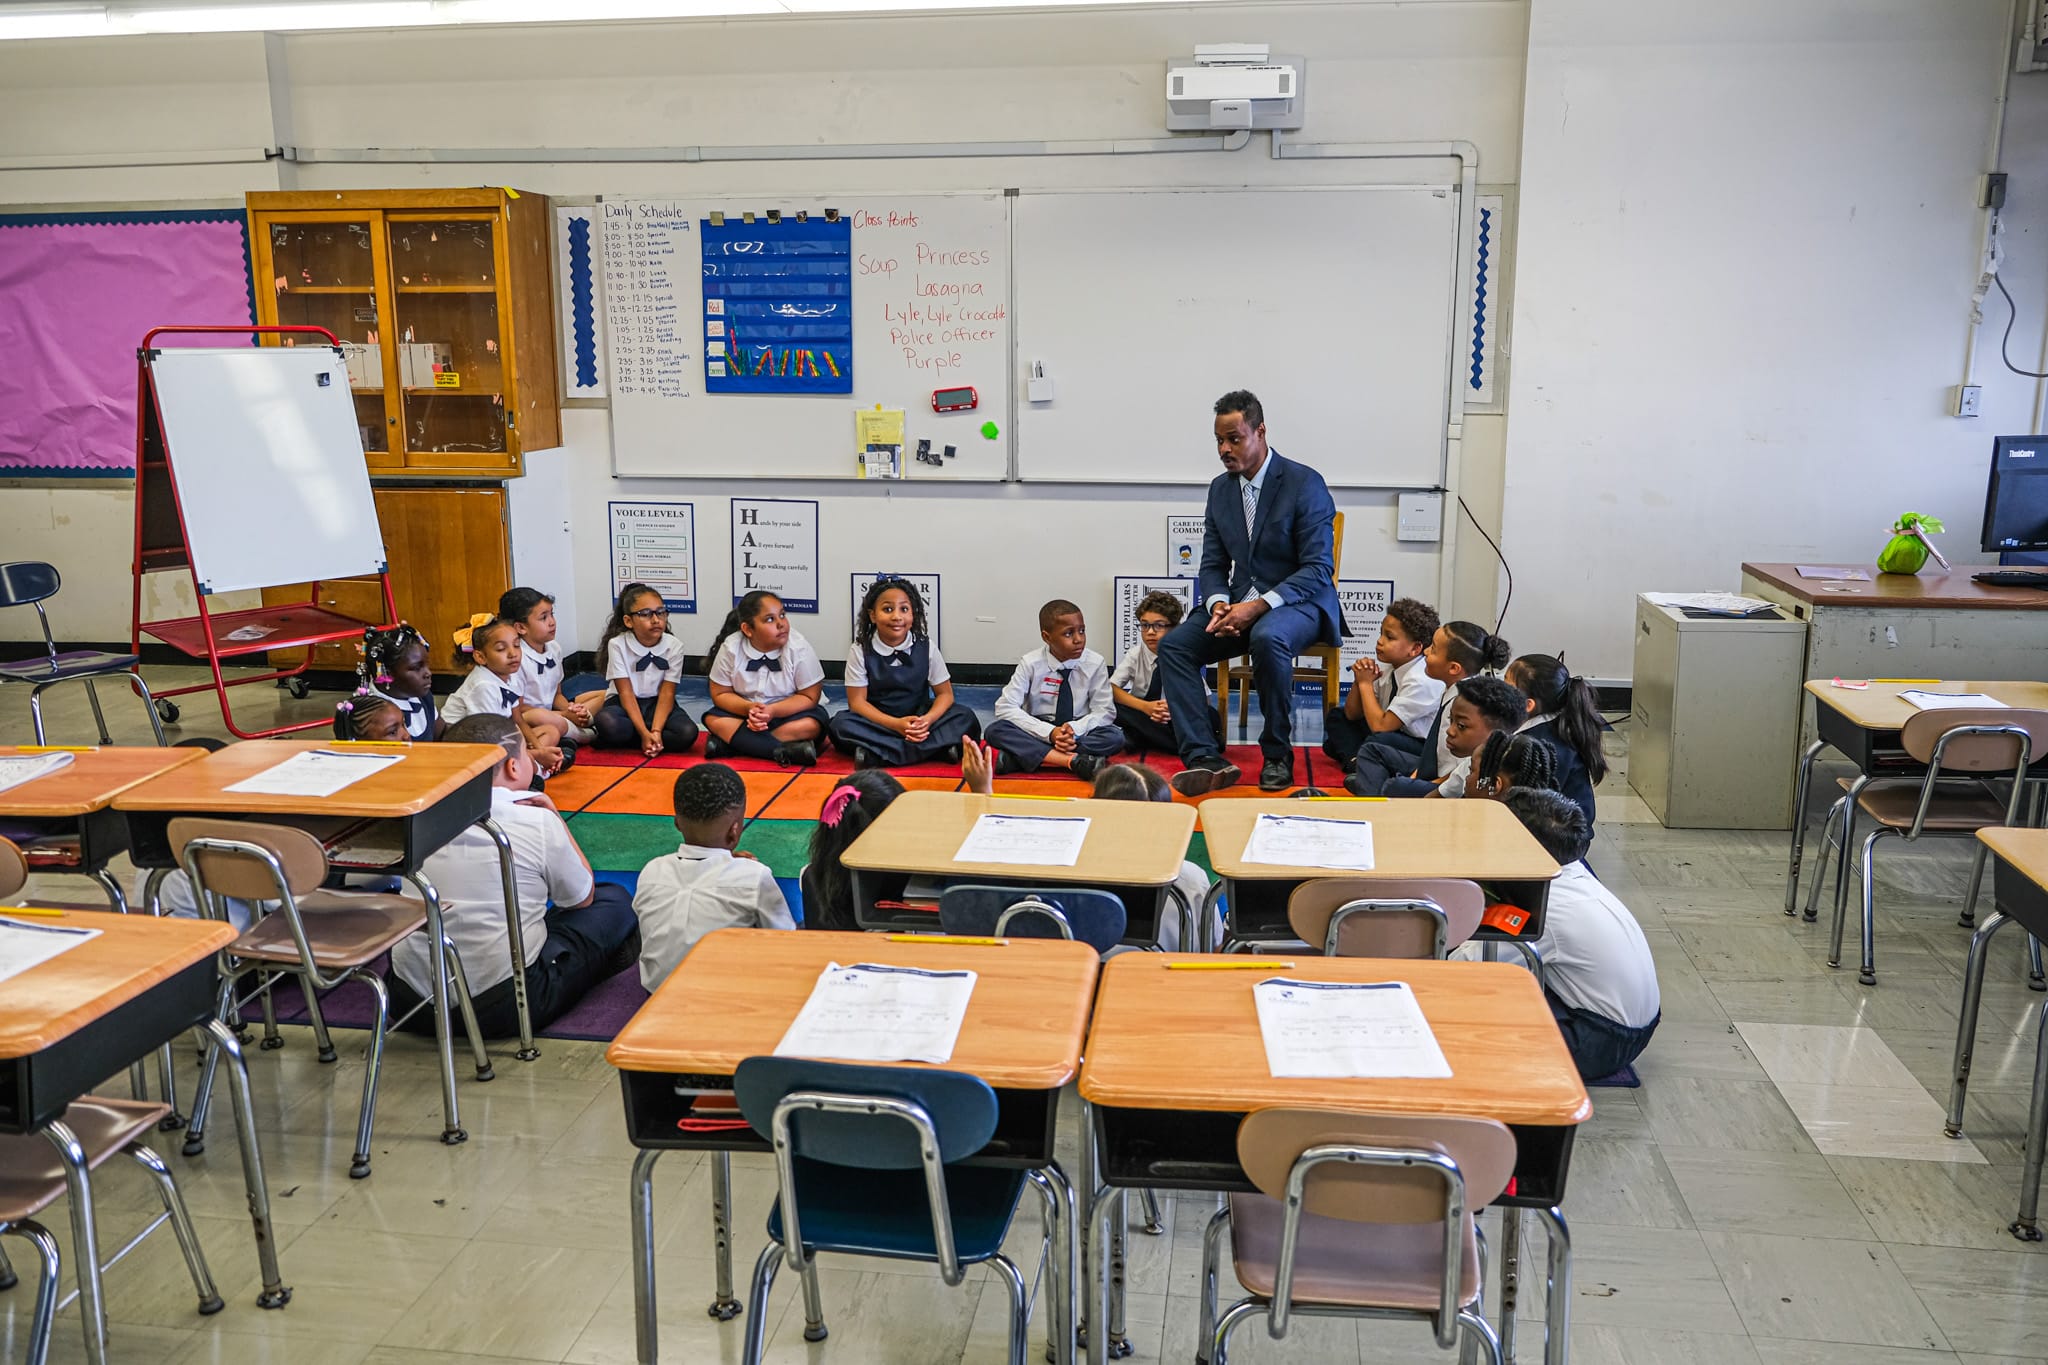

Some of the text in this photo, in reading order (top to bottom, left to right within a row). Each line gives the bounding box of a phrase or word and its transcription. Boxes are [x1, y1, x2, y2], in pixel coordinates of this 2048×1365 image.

[604, 202, 683, 221] Daily Schedule
[853, 209, 883, 229] Class
[916, 242, 990, 266] Princess
[858, 254, 898, 280] Soup
[916, 273, 984, 305] Lasagna
[890, 328, 934, 345] Police
[903, 347, 962, 377] Purple
[616, 509, 685, 518] VOICE LEVELS
[620, 522, 625, 530] 0
[622, 553, 627, 561] 2
[622, 568, 627, 576] 3
[1339, 591, 1384, 600] UPTIVE
[1344, 602, 1384, 612] VIORS
